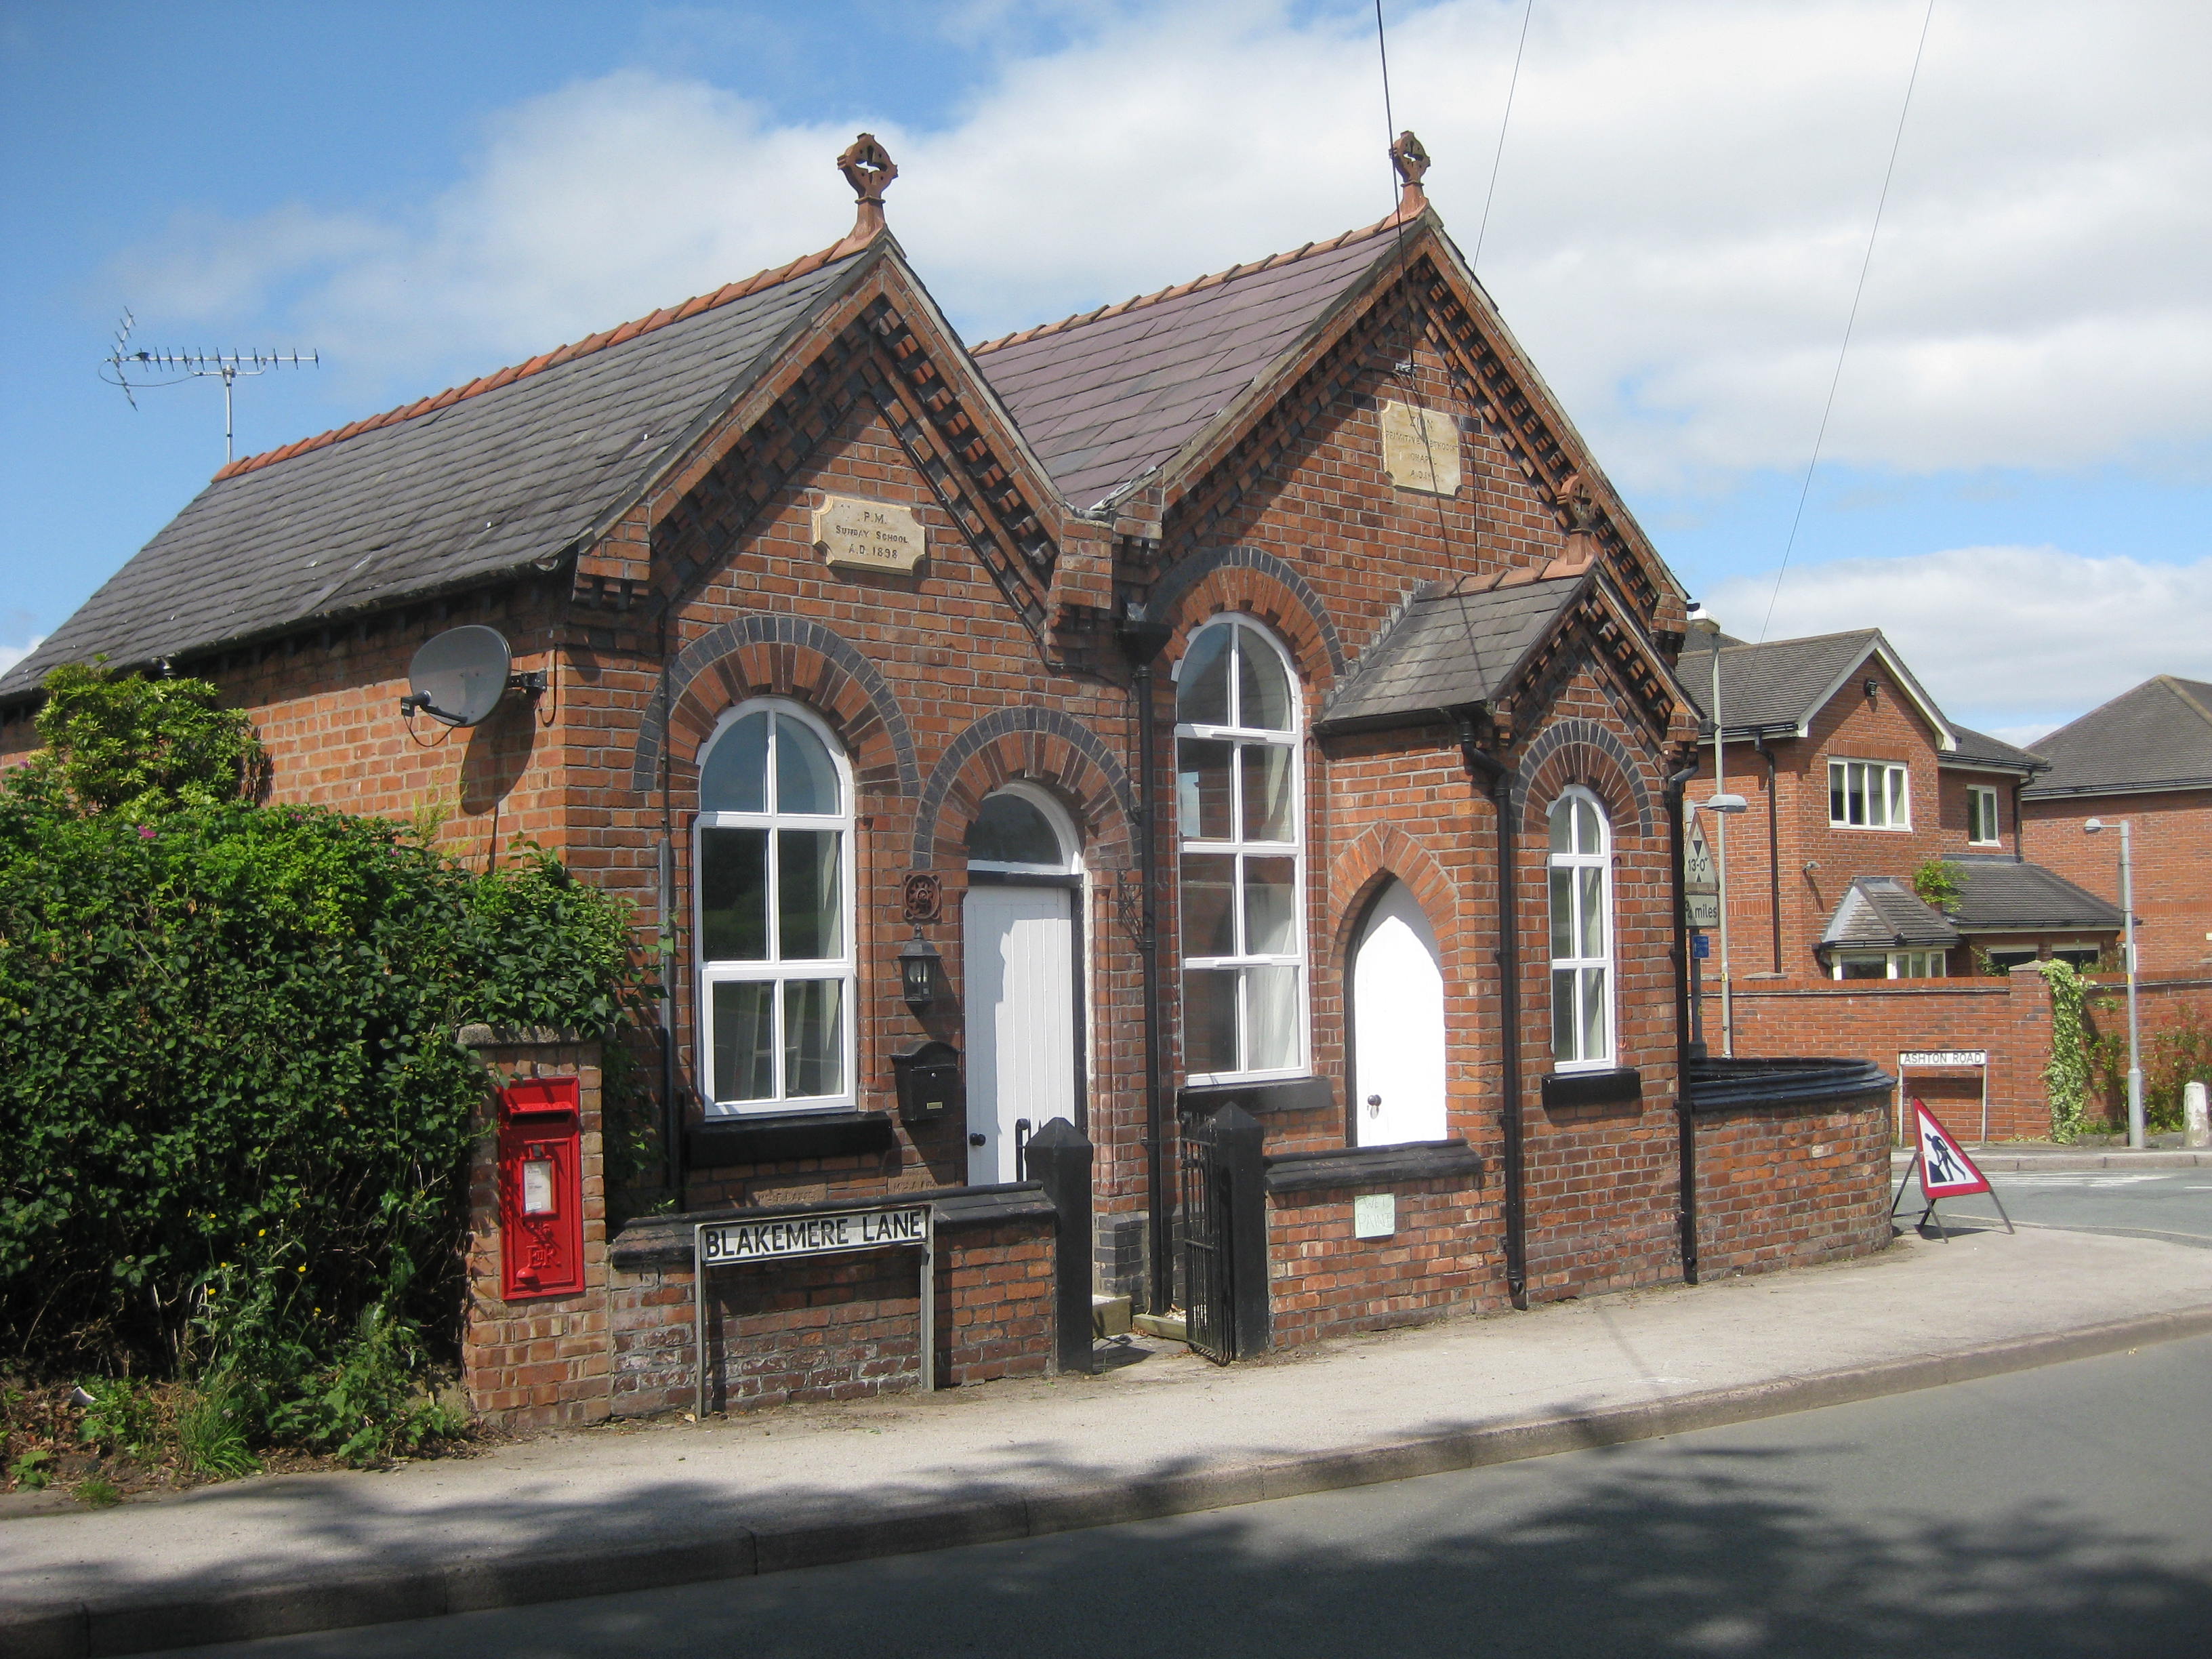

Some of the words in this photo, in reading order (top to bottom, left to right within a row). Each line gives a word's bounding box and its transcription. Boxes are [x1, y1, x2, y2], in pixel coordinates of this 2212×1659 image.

[1410, 416, 1433, 431] ZIN
[1386, 430, 1420, 445] PRIMITIVE
[1410, 453, 1437, 466] CHAPL
[836, 525, 869, 537] SUNDAY
[876, 531, 908, 544] SCHOOL
[872, 546, 899, 559] 1898
[1695, 903, 1717, 919] miles
[1904, 1052, 1947, 1063] ASHTON
[1952, 1052, 1982, 1063] ROAD
[705, 1218, 848, 1257] BLAKEMERE
[862, 1211, 922, 1242] LANE
